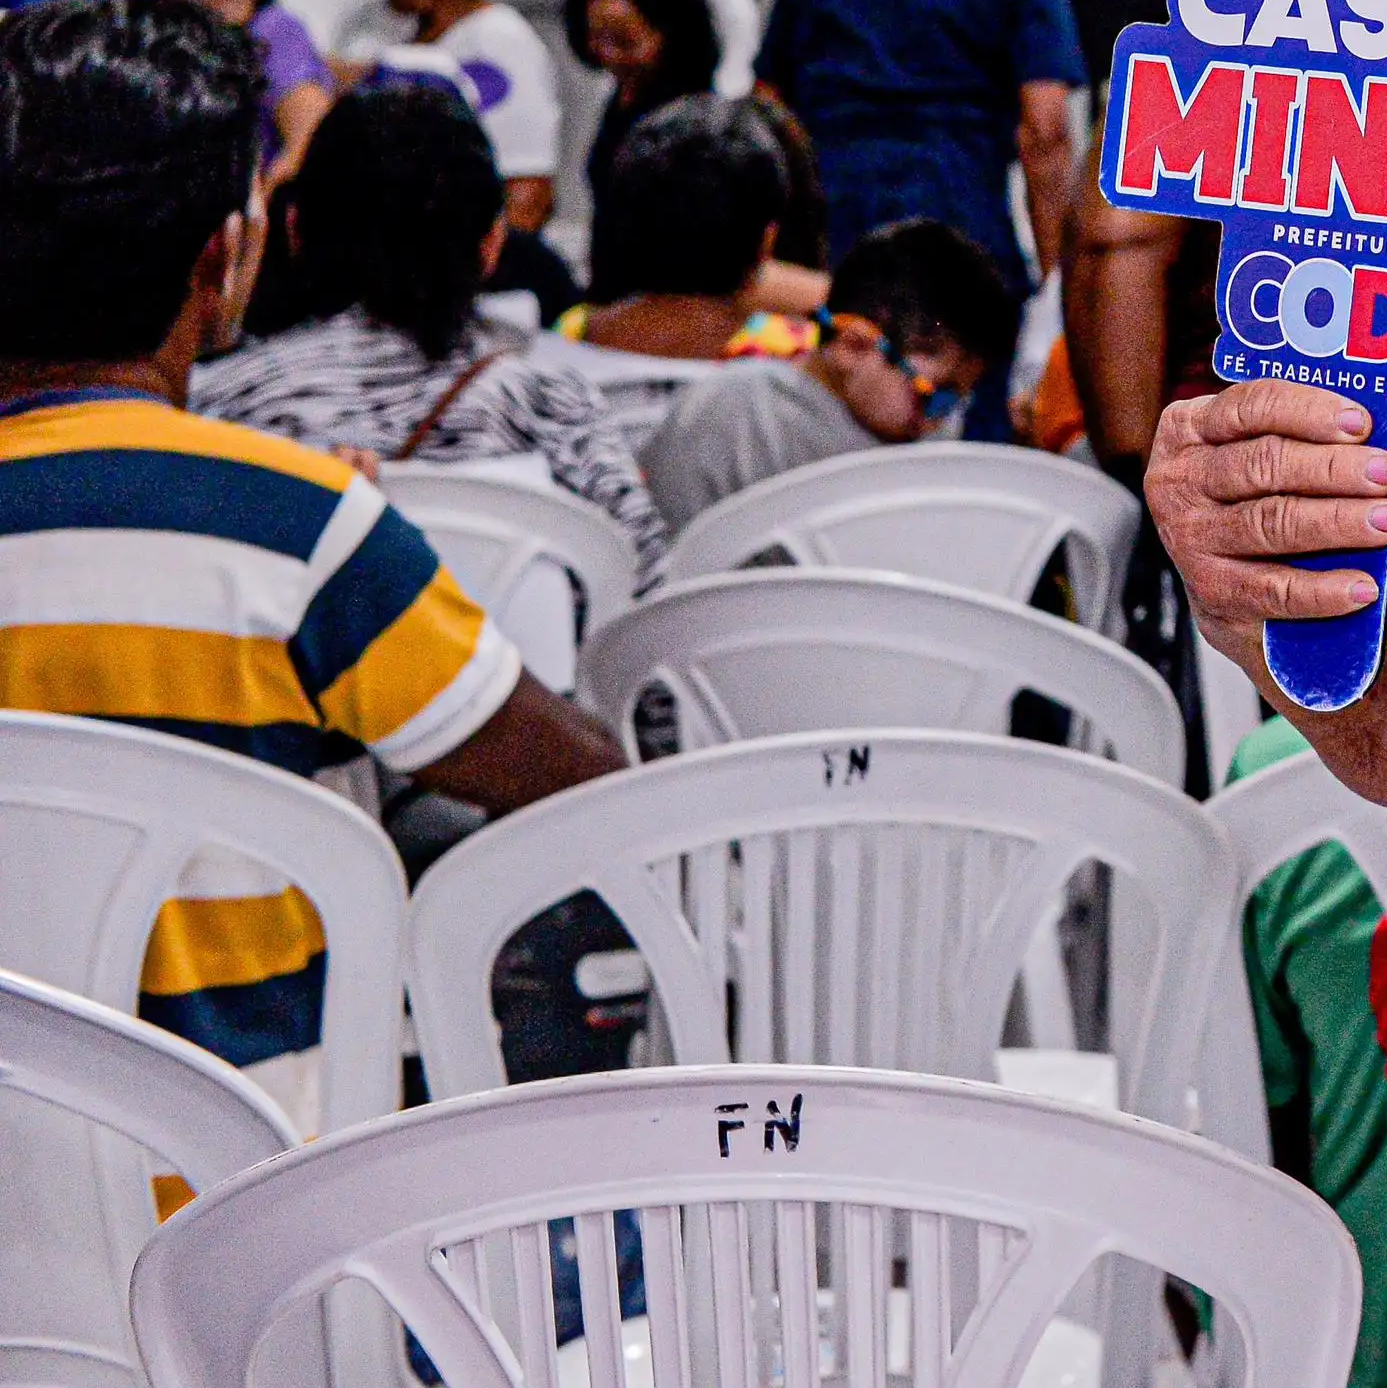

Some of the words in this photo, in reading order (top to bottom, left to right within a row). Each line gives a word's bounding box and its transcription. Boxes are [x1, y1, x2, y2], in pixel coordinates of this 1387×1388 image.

[1222, 353, 1251, 377] FÉ,
[1259, 359, 1367, 390] TRABALHO
[1374, 376, 1385, 394] E
[714, 1092, 803, 1158] FN
